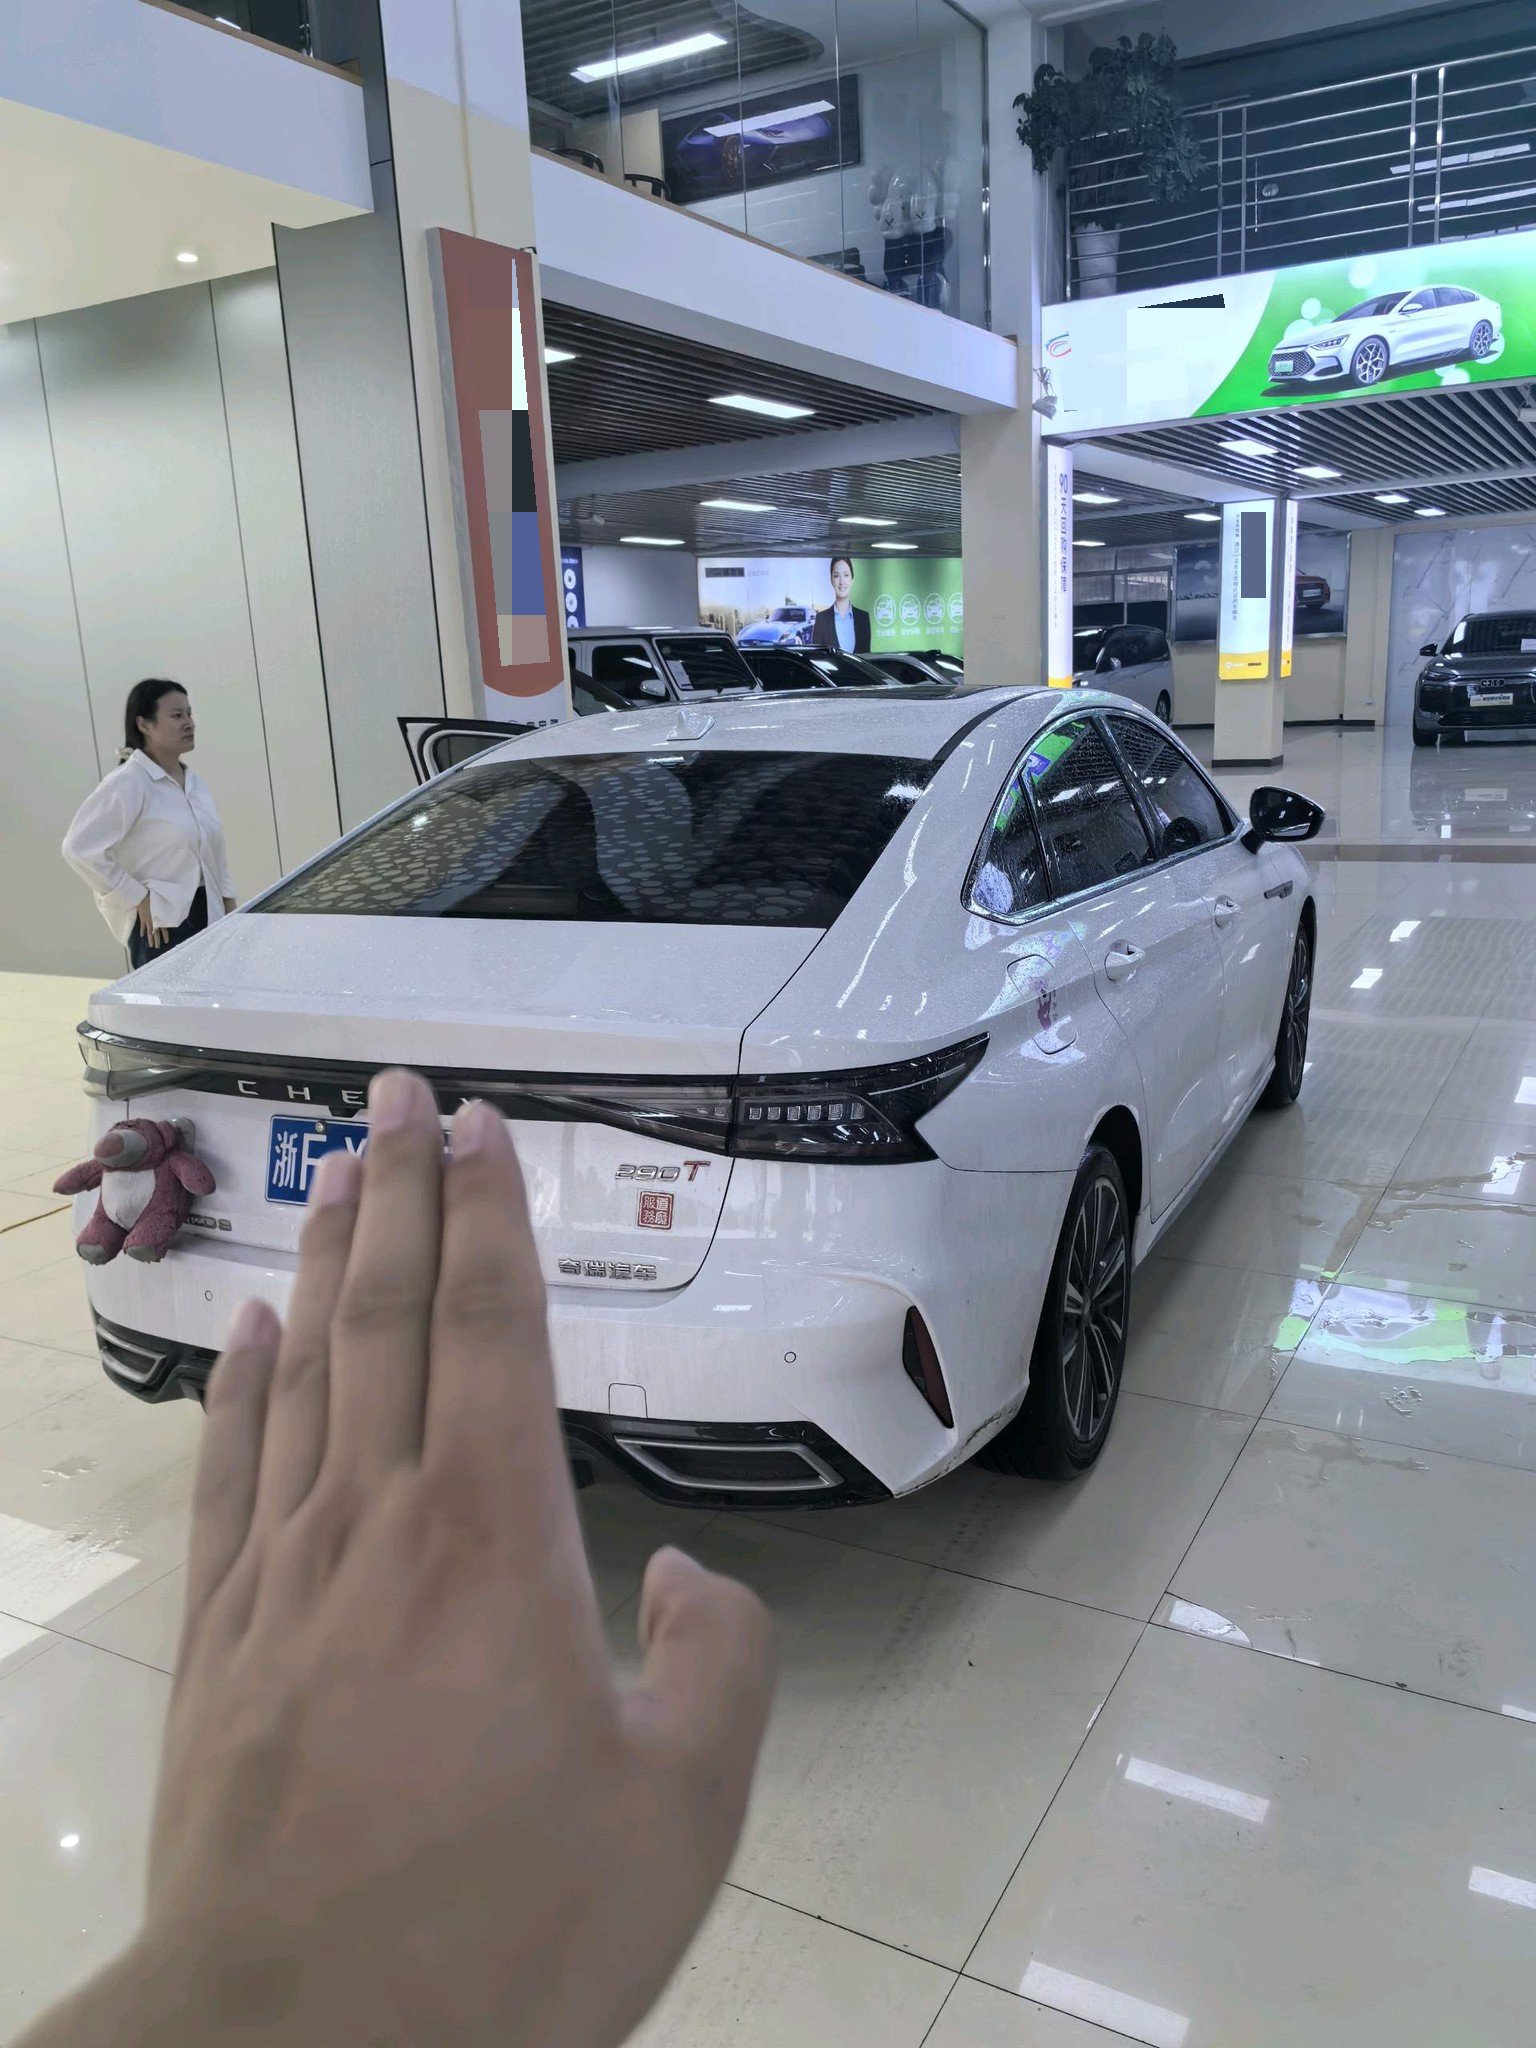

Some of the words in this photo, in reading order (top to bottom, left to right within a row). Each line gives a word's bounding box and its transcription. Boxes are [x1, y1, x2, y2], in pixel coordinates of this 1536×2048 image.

[615, 1160, 711, 1182] 290T
[558, 1258, 657, 1281] 奇瑞汽车
